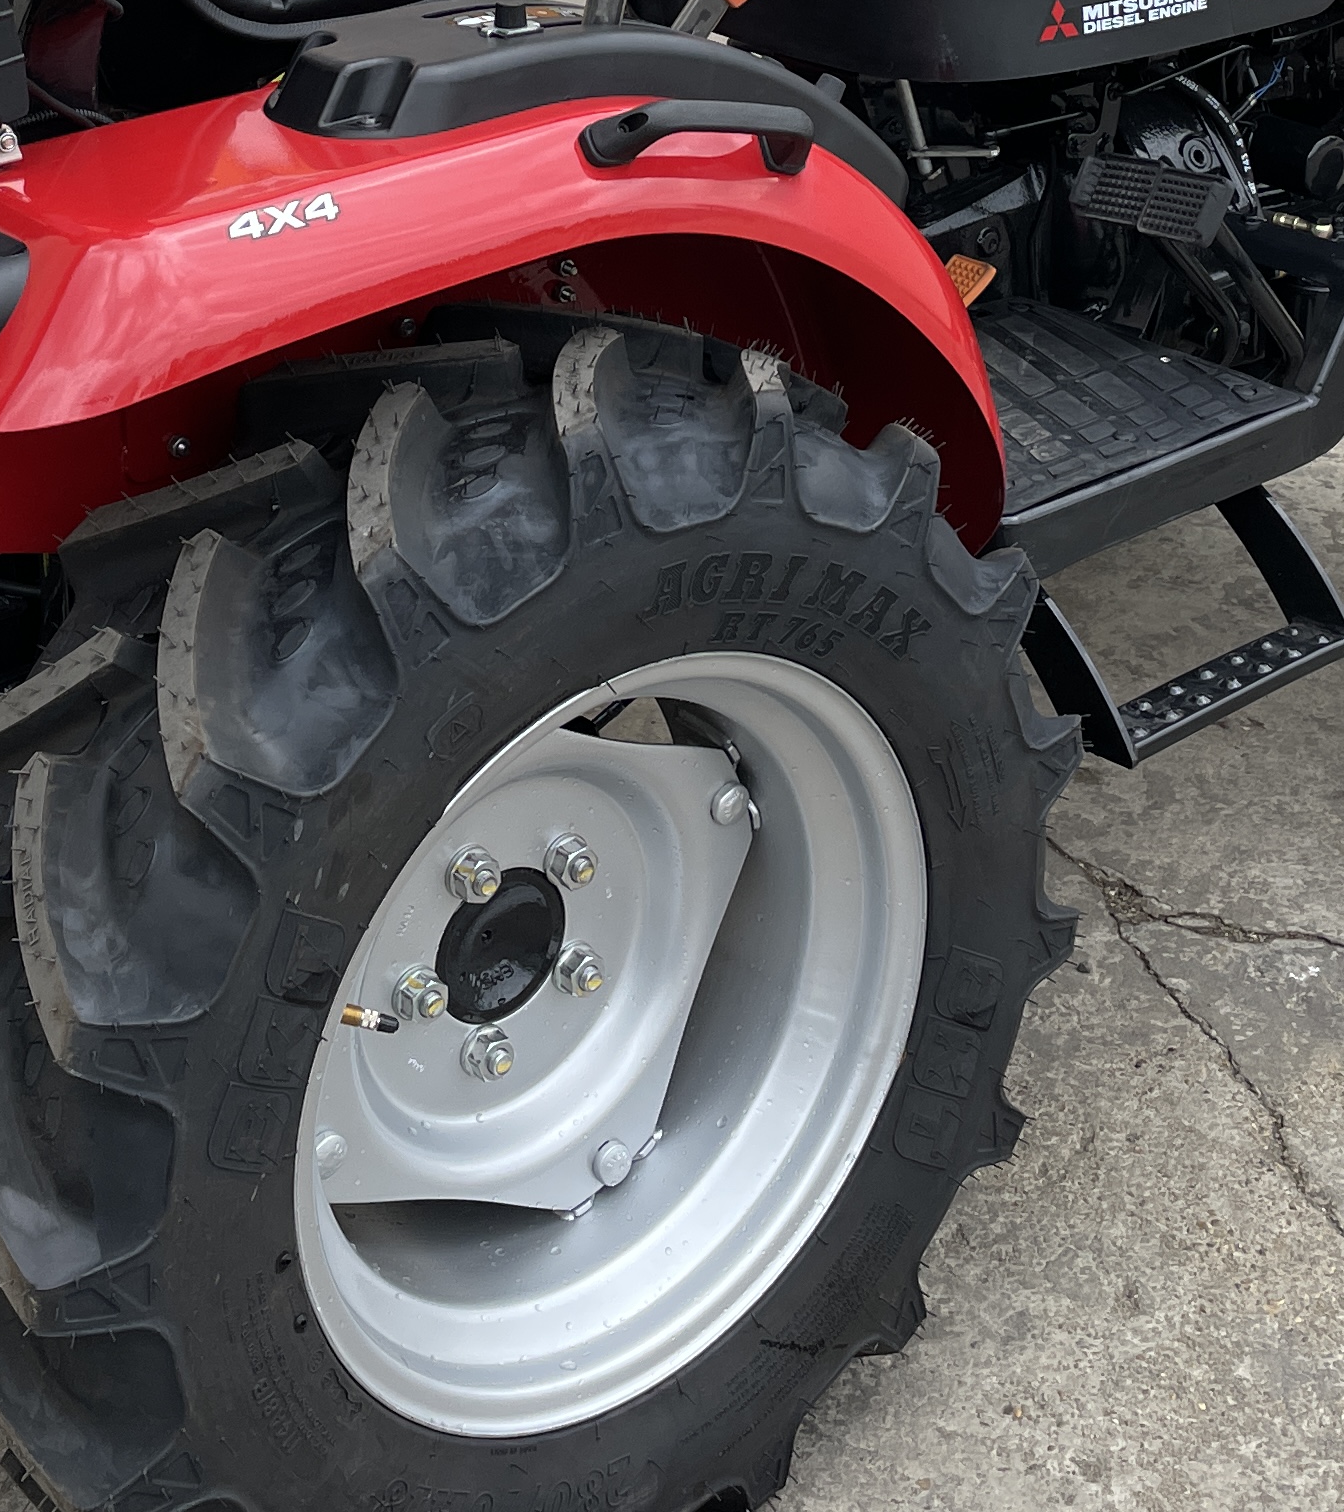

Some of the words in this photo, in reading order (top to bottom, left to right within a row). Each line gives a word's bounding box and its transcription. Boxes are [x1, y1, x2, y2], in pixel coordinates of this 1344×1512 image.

[1083, 13, 1145, 35] DIESEL
[227, 191, 341, 240] 4X4
[777, 615, 846, 658] 765
